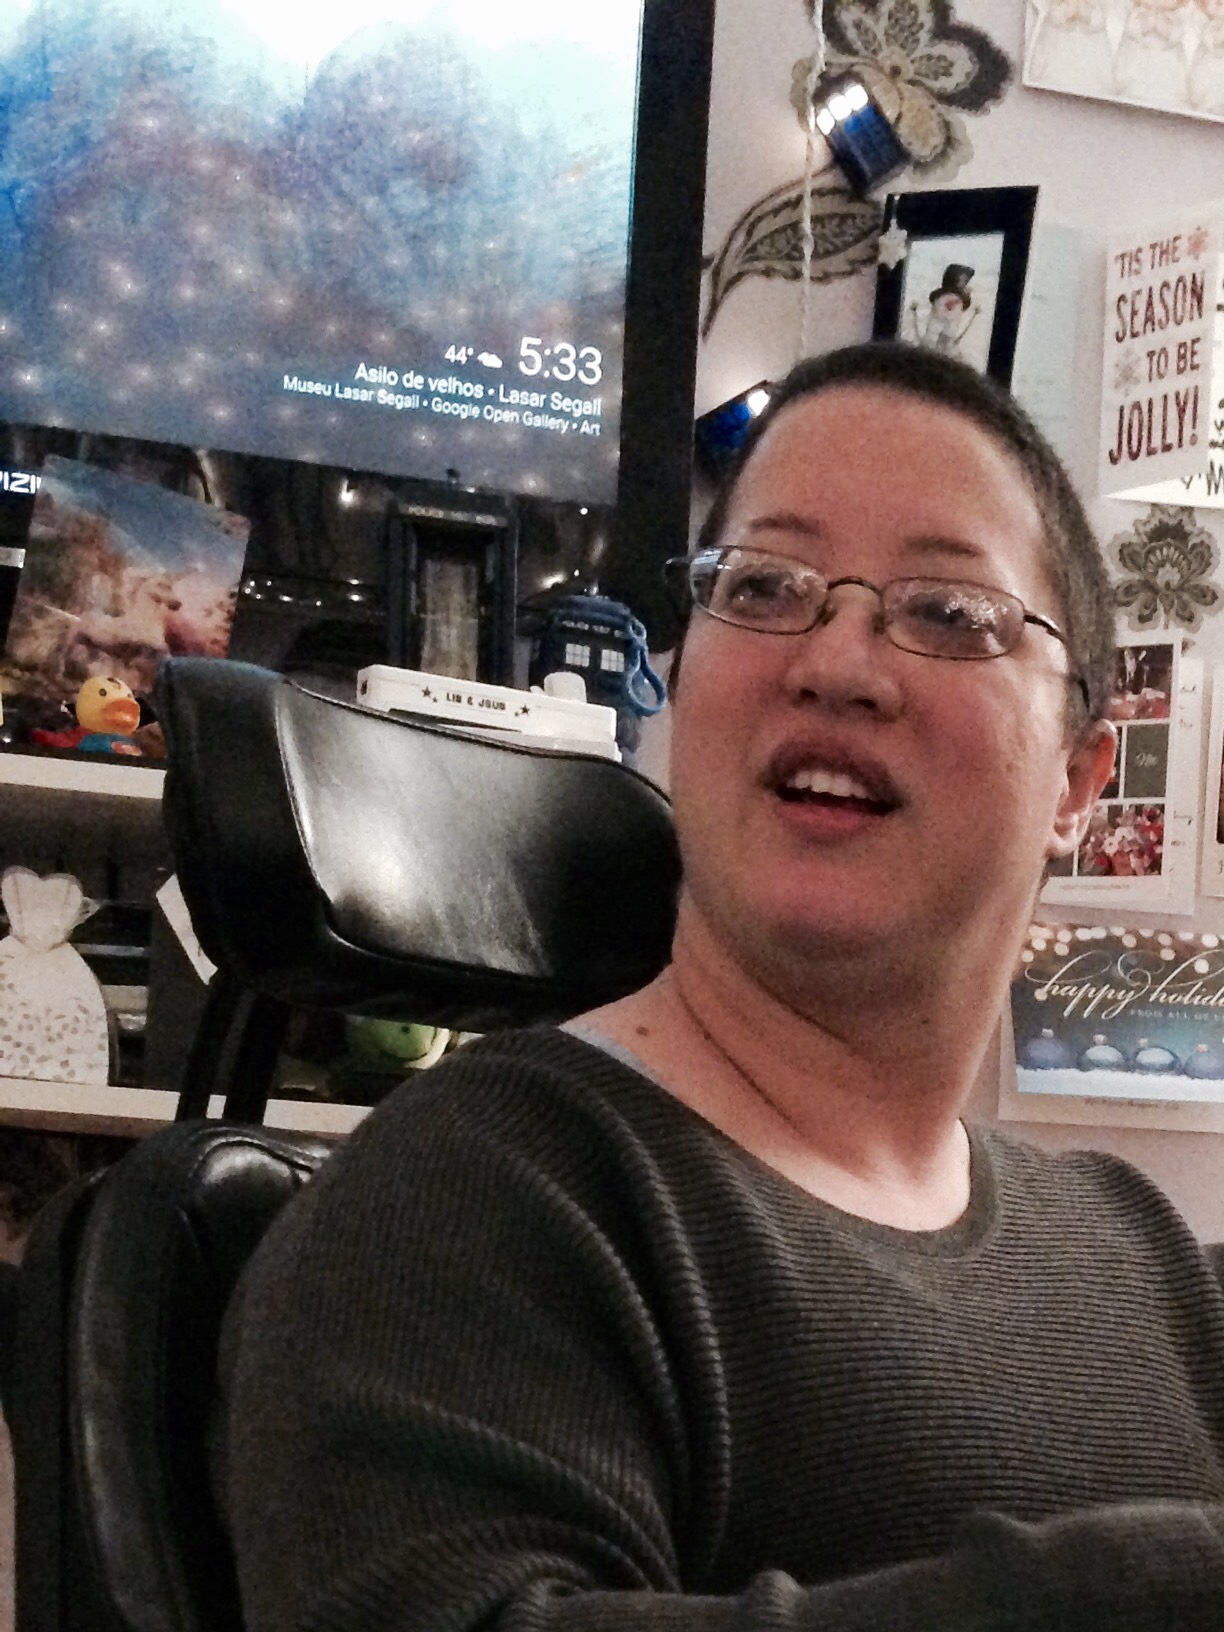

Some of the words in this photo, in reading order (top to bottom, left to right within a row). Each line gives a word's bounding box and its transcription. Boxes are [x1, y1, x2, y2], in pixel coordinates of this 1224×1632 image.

[1149, 235, 1182, 270] THE
[1115, 271, 1205, 344] SEASON
[518, 336, 602, 385] 5:33
[1146, 347, 1169, 382] TO
[1176, 337, 1201, 375] BE
[283, 375, 332, 397] Museu
[335, 384, 374, 402] Lasar
[377, 388, 420, 410] Segall
[431, 397, 481, 419] Google
[483, 405, 520, 424] Open
[523, 411, 570, 435] Gallery
[580, 419, 602, 436] Art
[355, 362, 399, 386] Asilo
[402, 370, 425, 390] de
[428, 375, 484, 399] velhos
[499, 384, 547, 408] Lasar
[551, 392, 602, 417] Segall
[1109, 385, 1200, 466] JOLLY!
[0, 471, 42, 494] IZI
[1025, 950, 1152, 1020] happy
